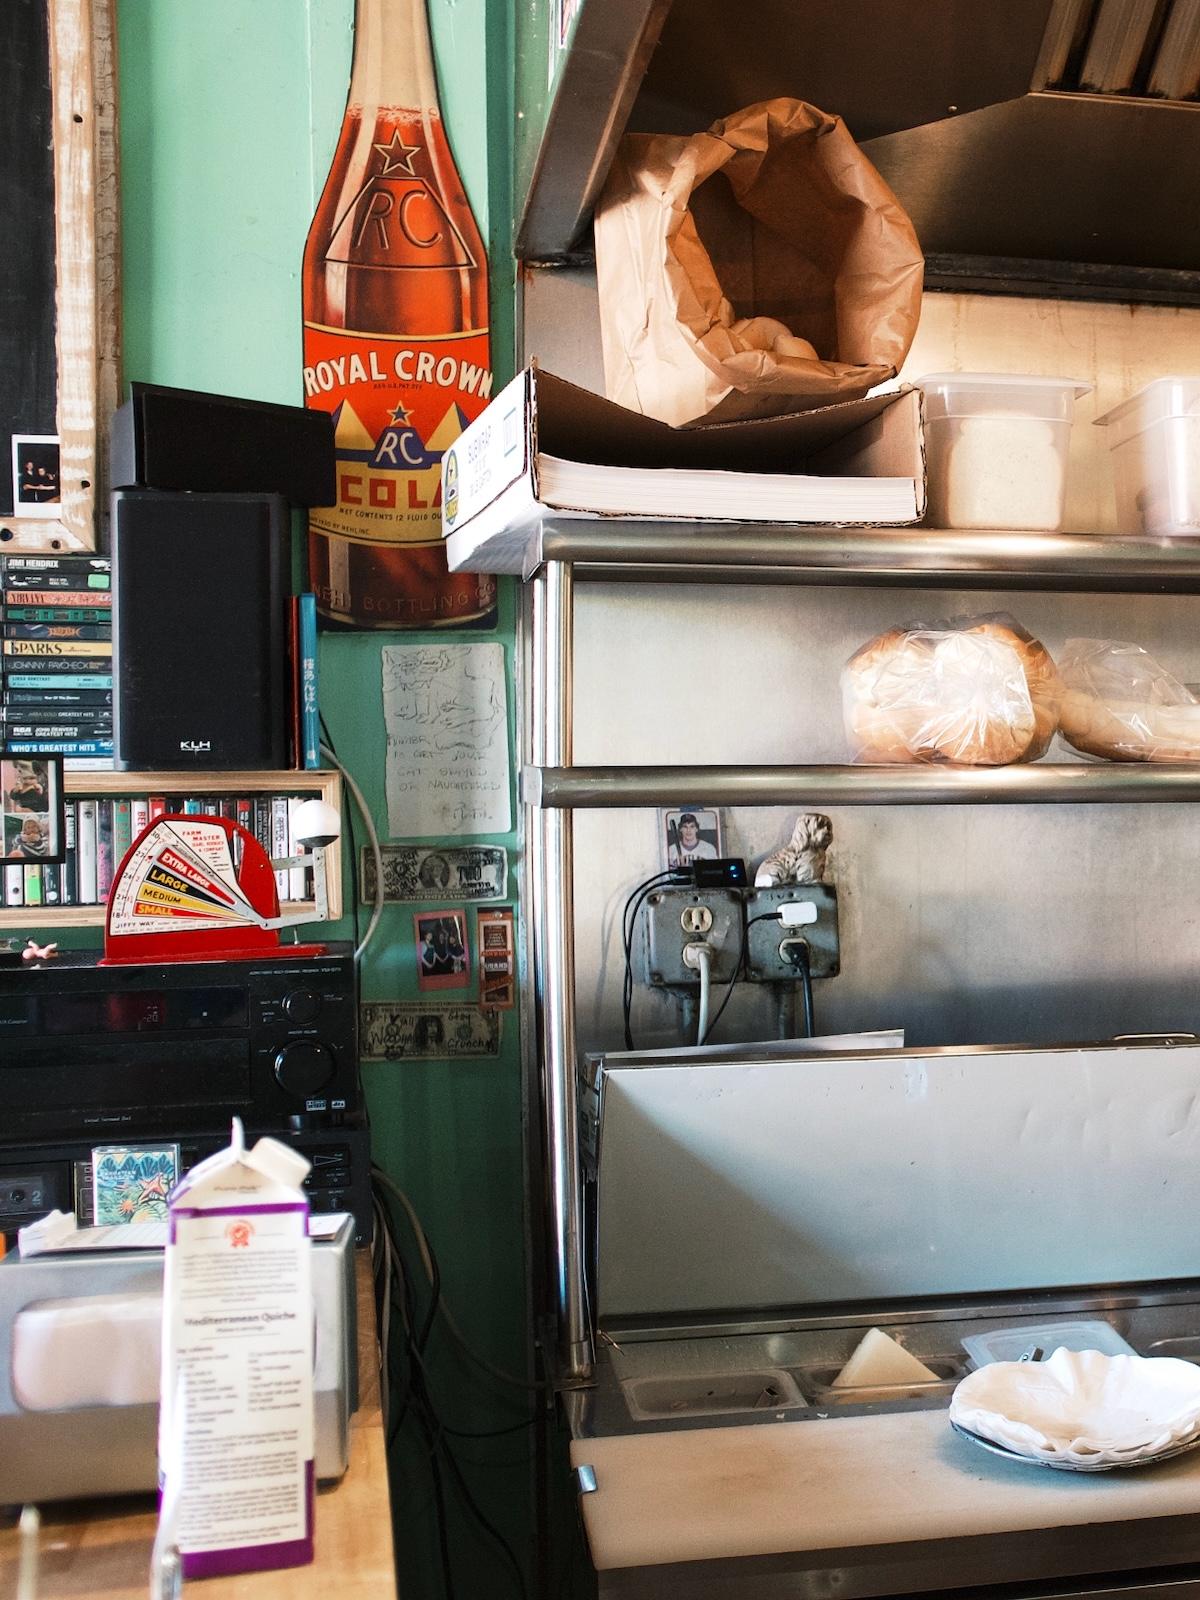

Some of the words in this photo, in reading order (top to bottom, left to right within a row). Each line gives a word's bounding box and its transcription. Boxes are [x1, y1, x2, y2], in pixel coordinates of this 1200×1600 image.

[353, 188, 443, 250] RC
[303, 351, 387, 397] ROYAL
[394, 350, 493, 399] CROWN
[375, 432, 423, 465] RC
[355, 510, 393, 521] CONTENTS
[407, 513, 428, 521] FLUID
[26, 560, 59, 568] HENDRIX
[11, 594, 45, 603] NIRVANA
[363, 594, 468, 613] BOTTLING
[14, 642, 63, 655] SPARKS
[11, 661, 46, 670] JOHNNY
[48, 661, 89, 670] PAYCHECK
[39, 744, 77, 752] GREATEST
[79, 743, 96, 752] HITS
[180, 741, 211, 751] KLH
[123, 872, 132, 880] 24
[161, 853, 187, 876] EXTRA
[187, 870, 211, 889] LARGE
[151, 869, 189, 893] LARGE
[143, 889, 182, 904] MEDIUM
[138, 904, 174, 916] SMALL
[115, 921, 136, 929] JIFFY
[184, 1315, 259, 1327] Mediterranean
[261, 1312, 296, 1323] Quiche
